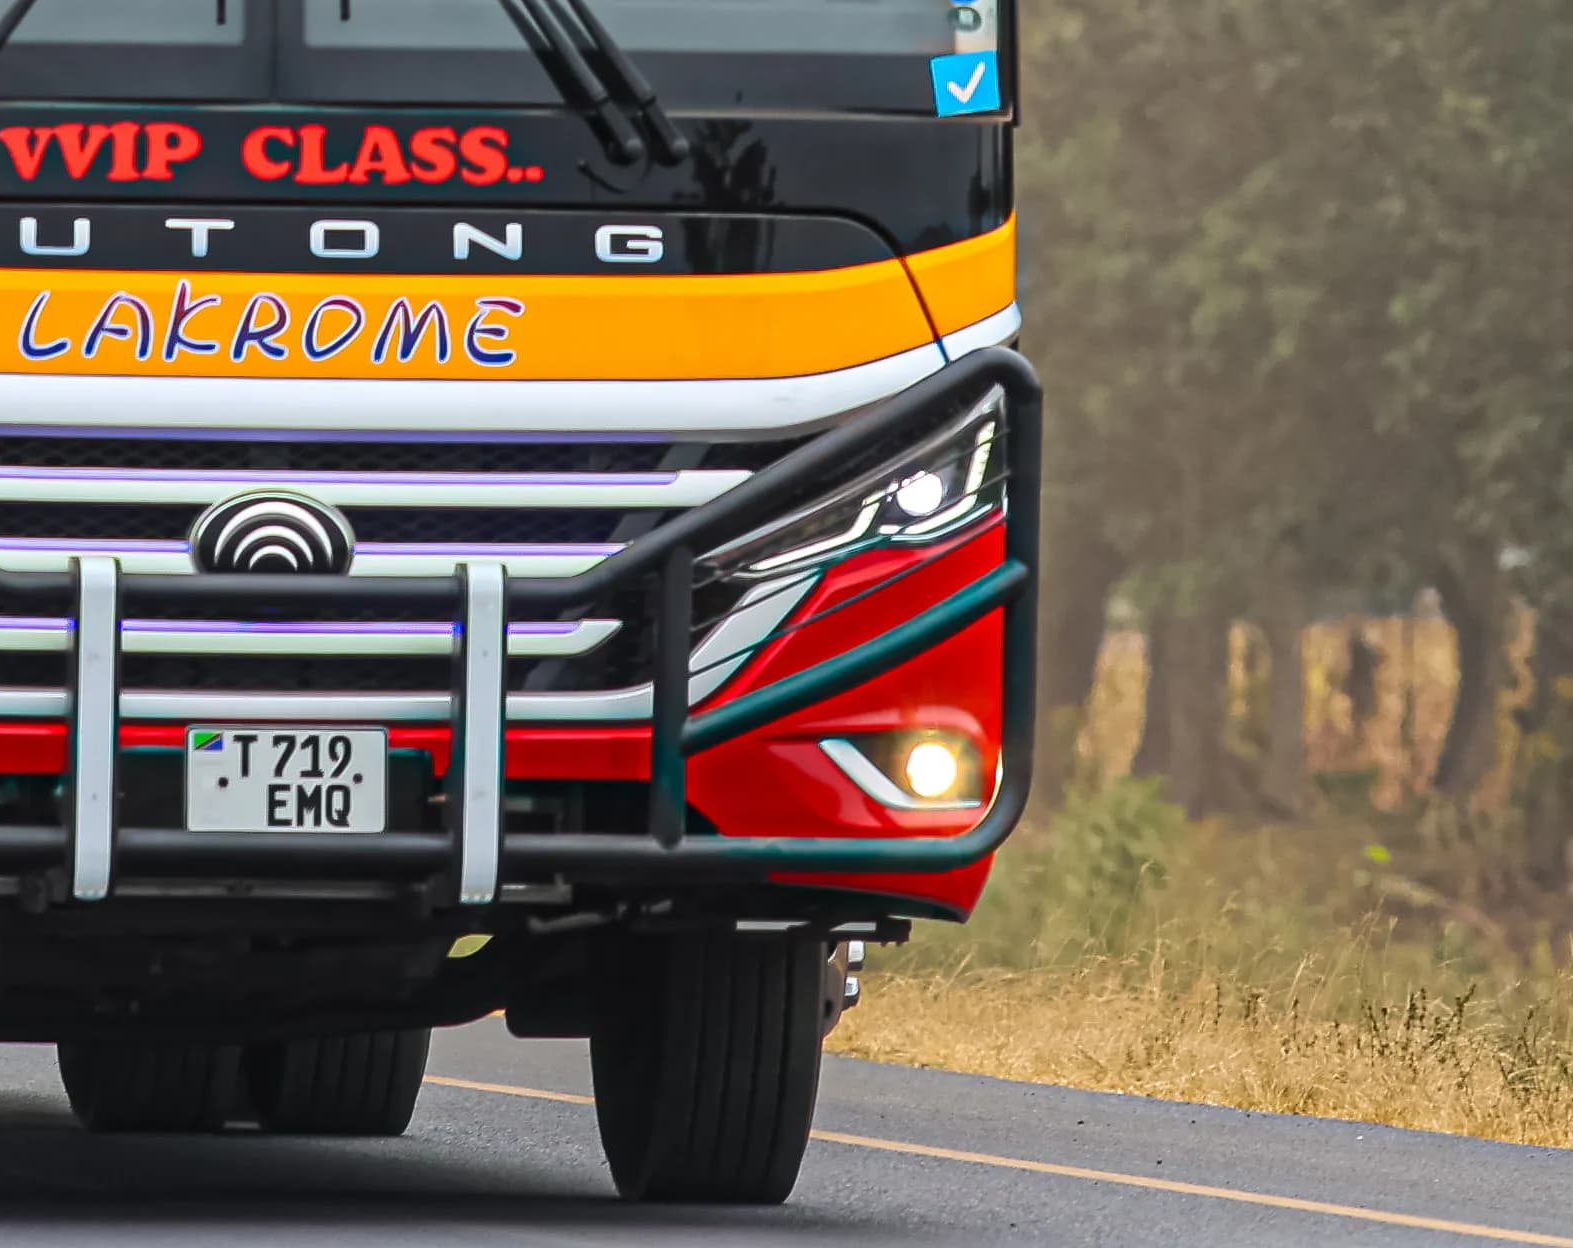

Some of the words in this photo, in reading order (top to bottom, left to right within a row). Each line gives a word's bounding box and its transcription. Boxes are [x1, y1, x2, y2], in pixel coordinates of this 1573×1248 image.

[241, 124, 545, 187] CLASS..
[17, 279, 527, 367] LAKROME
[233, 734, 258, 778] T
[272, 734, 353, 779] 719
[267, 783, 351, 829] EMQ
